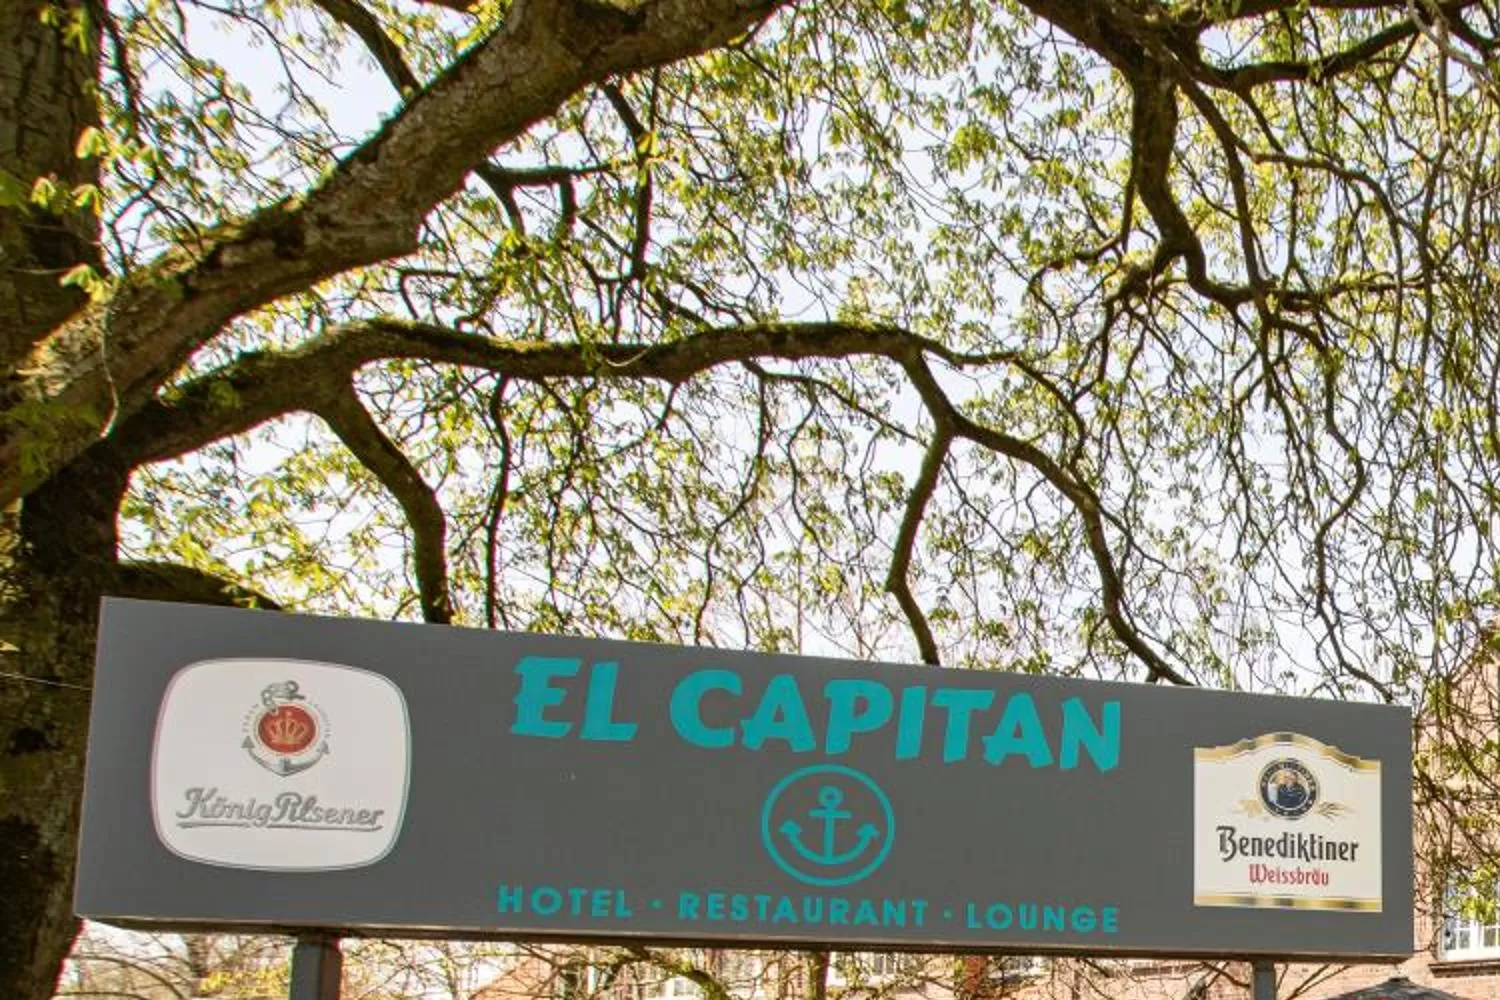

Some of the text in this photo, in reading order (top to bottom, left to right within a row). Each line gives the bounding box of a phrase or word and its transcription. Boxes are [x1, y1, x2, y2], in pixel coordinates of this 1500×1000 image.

[510, 655, 1121, 773] EL CAPITAN
[1215, 825, 1359, 863] Benediktiner
[1249, 864, 1330, 886] Weissbräu
[497, 884, 1120, 934] HOTEL RESTAURANT LOUNGE
